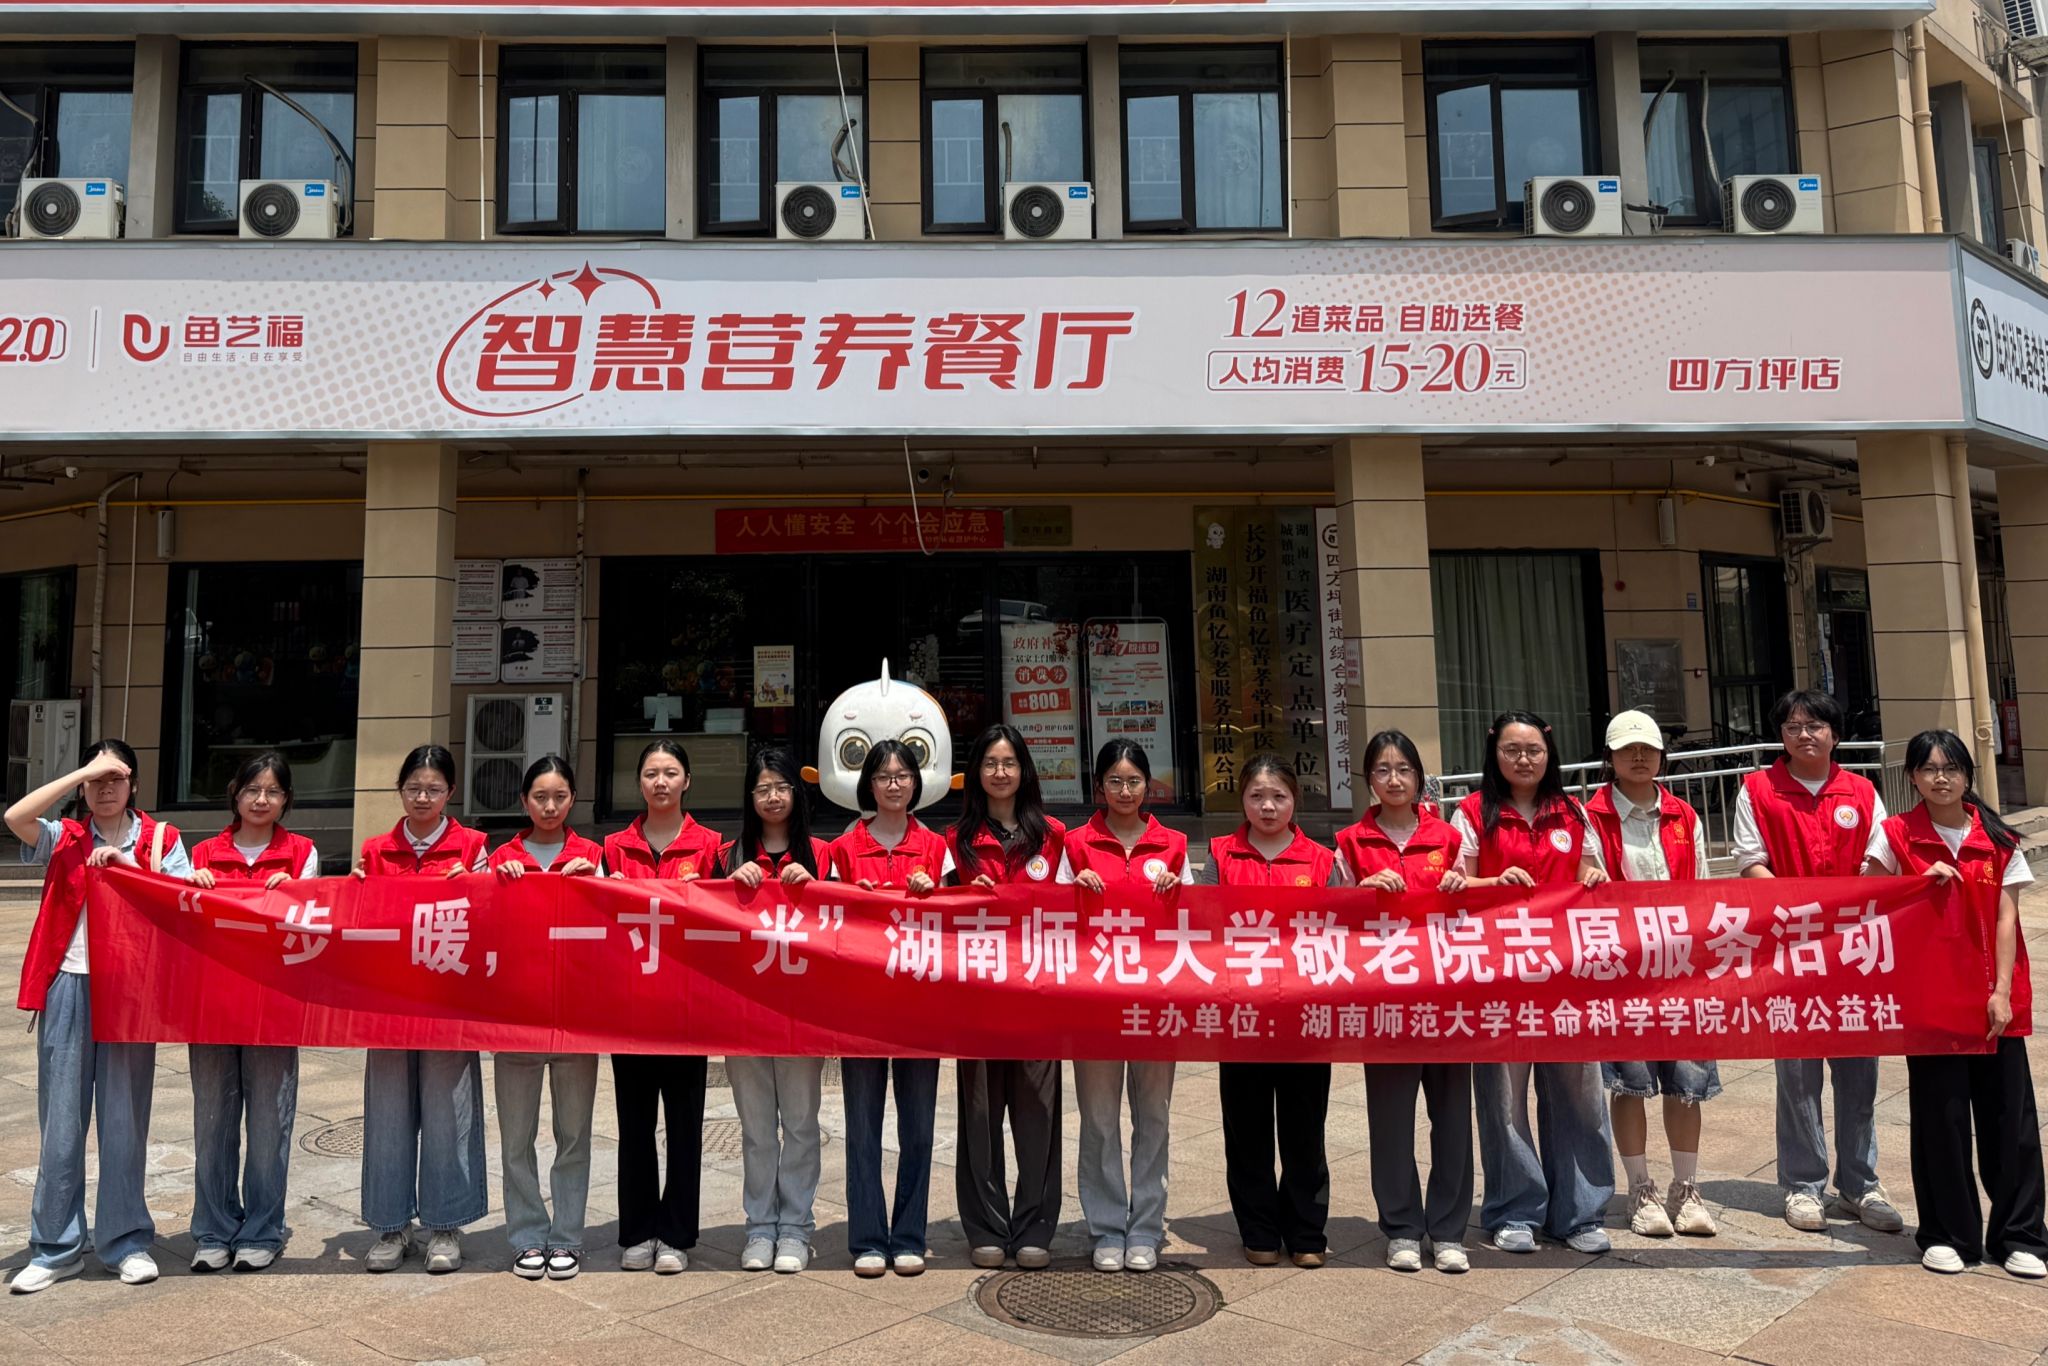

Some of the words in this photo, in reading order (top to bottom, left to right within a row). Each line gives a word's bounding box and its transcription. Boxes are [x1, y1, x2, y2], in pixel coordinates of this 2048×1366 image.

[184, 315, 304, 348] 鱼艺福
[1400, 302, 1525, 333] 自助选餐
[183, 351, 303, 363] 自由生活·自在享受
[476, 311, 1135, 392] 智慧营养餐厅
[1668, 358, 1841, 391] 四方坪店
[735, 512, 856, 537] 人人懂安全
[869, 511, 990, 536] 个个会应急
[1245, 523, 1275, 750] 长沙开福鱼忆善孝堂中医
[1205, 566, 1236, 795] 湖南鱼忆养老服务有限公司
[1284, 588, 1320, 778] 医疗定点单位
